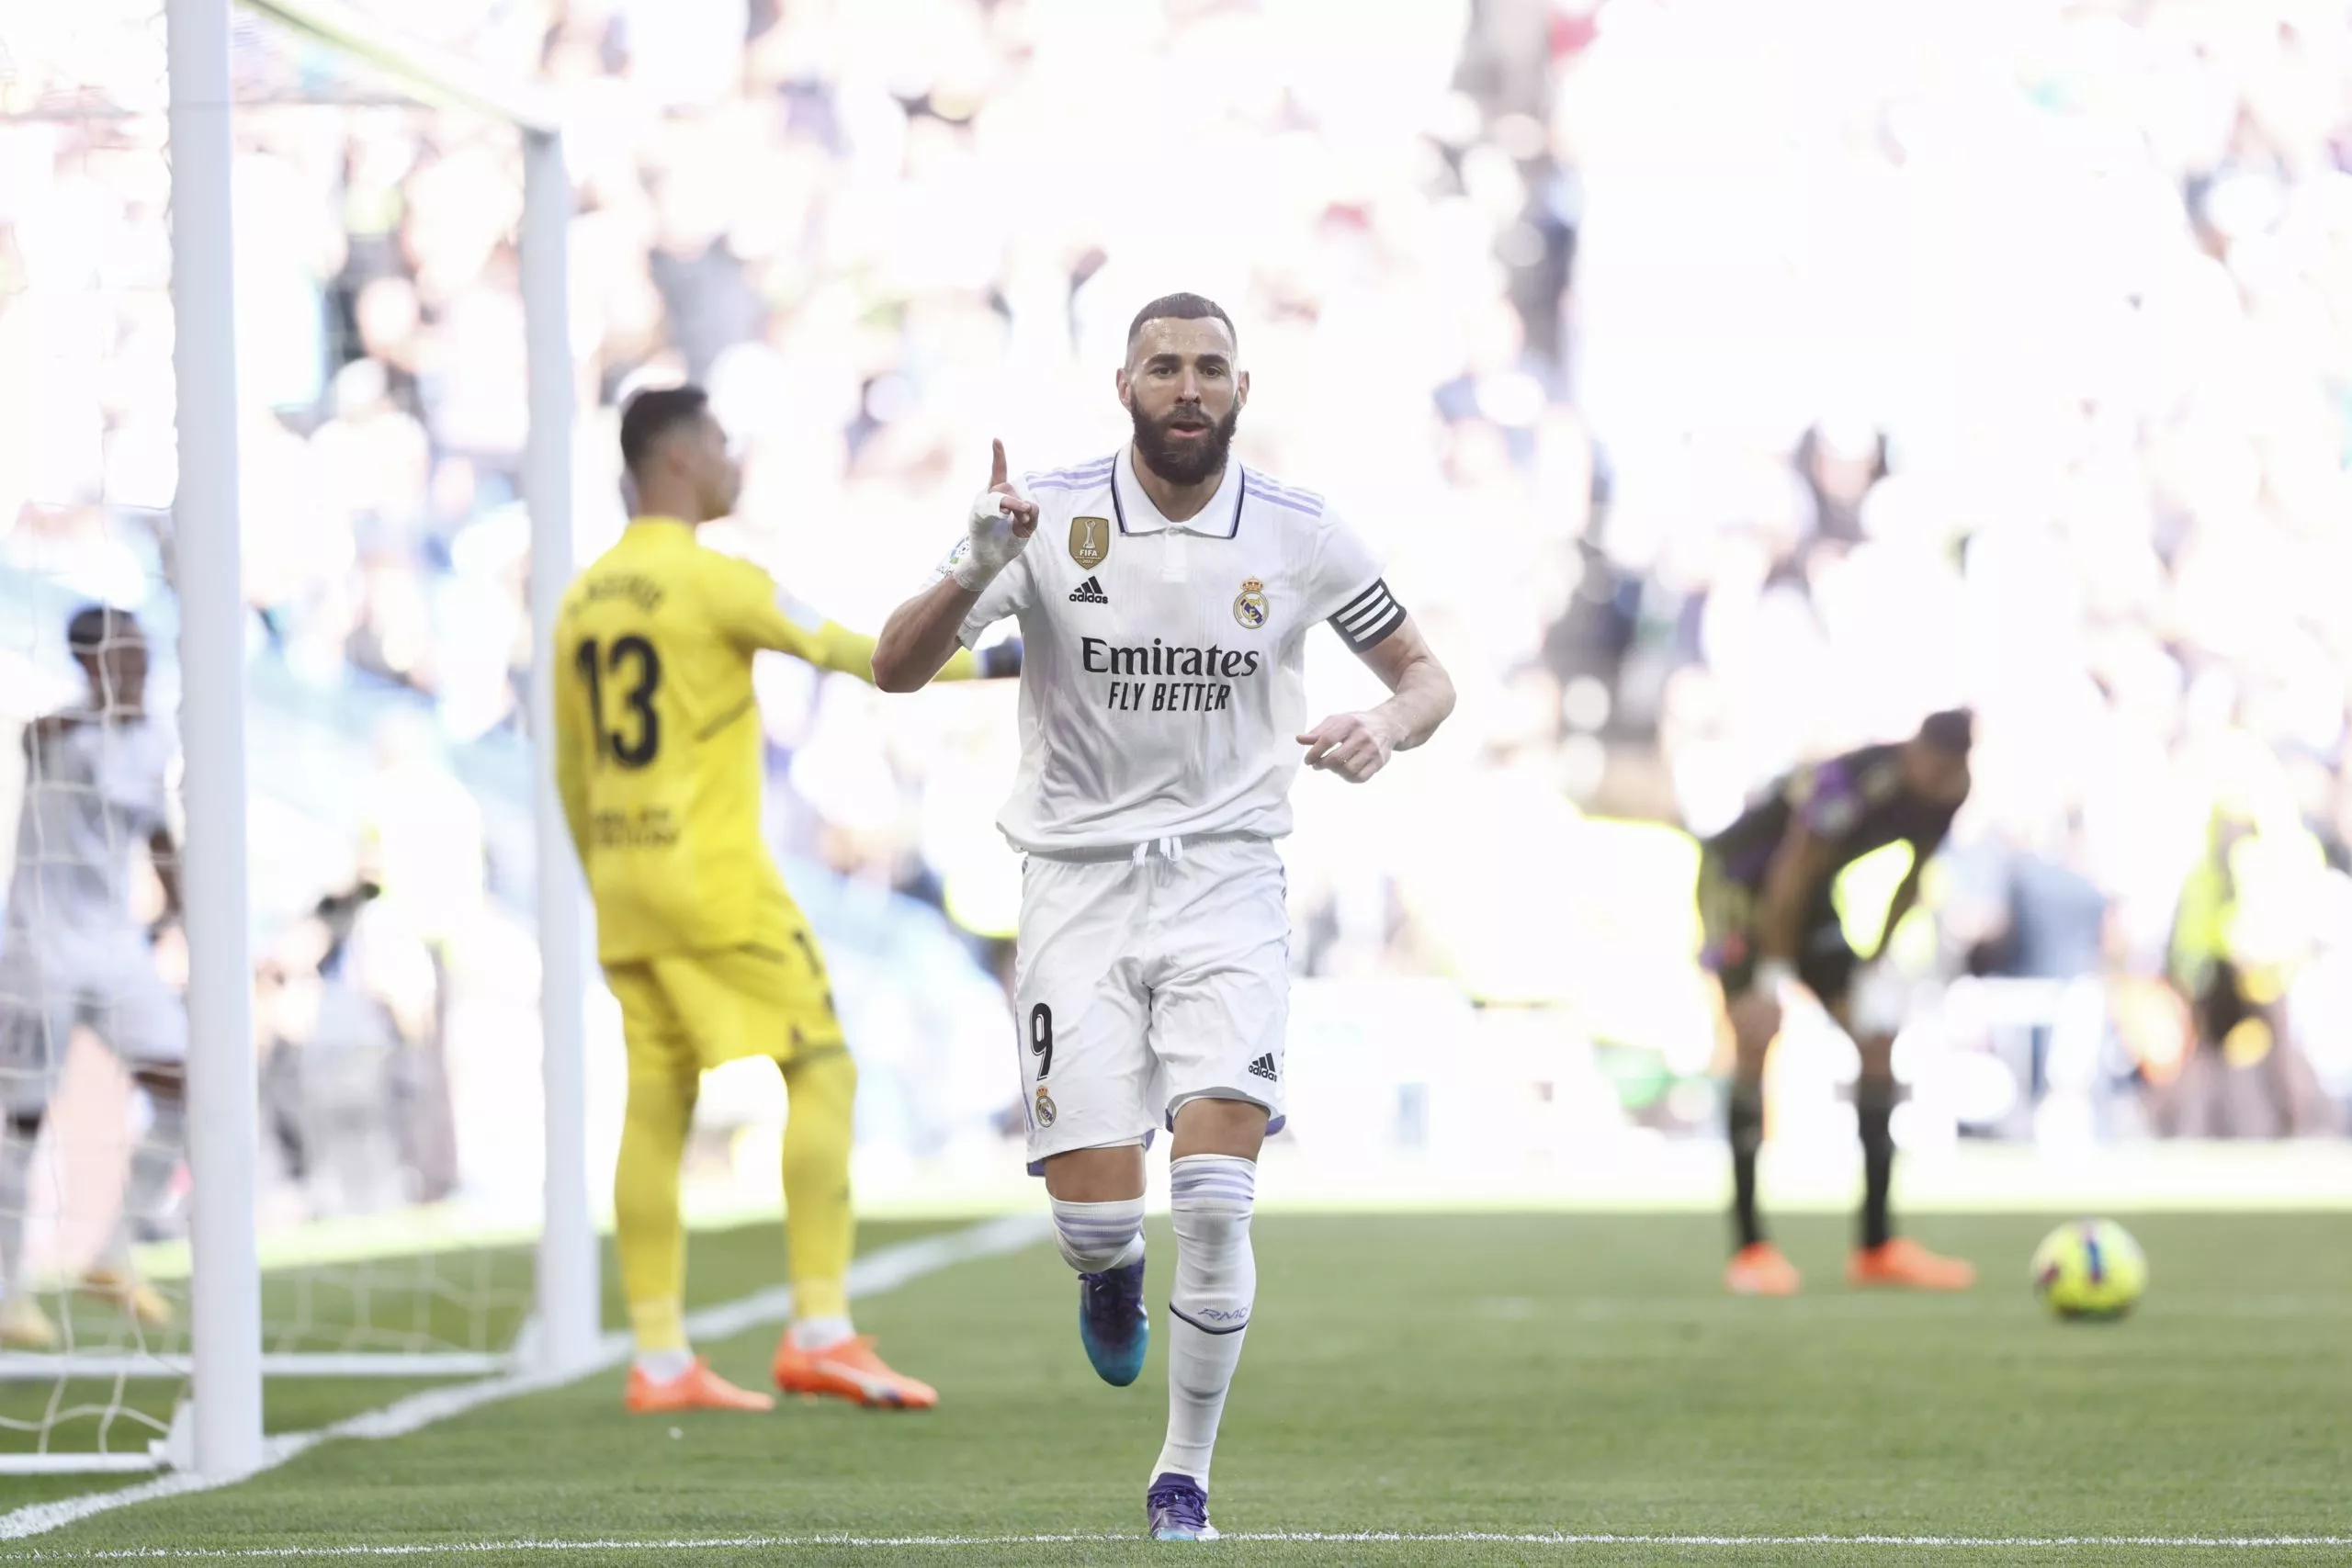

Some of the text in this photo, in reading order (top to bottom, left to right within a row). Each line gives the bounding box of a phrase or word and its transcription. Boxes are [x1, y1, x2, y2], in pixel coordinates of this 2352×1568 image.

[1069, 591, 1109, 604] adidas
[1081, 637, 1260, 678] Emirates
[576, 632, 660, 769] 13
[1108, 682, 1231, 712] FLY BETTER
[1029, 1002, 1053, 1082] 9
[1248, 1065, 1278, 1082] adidas
